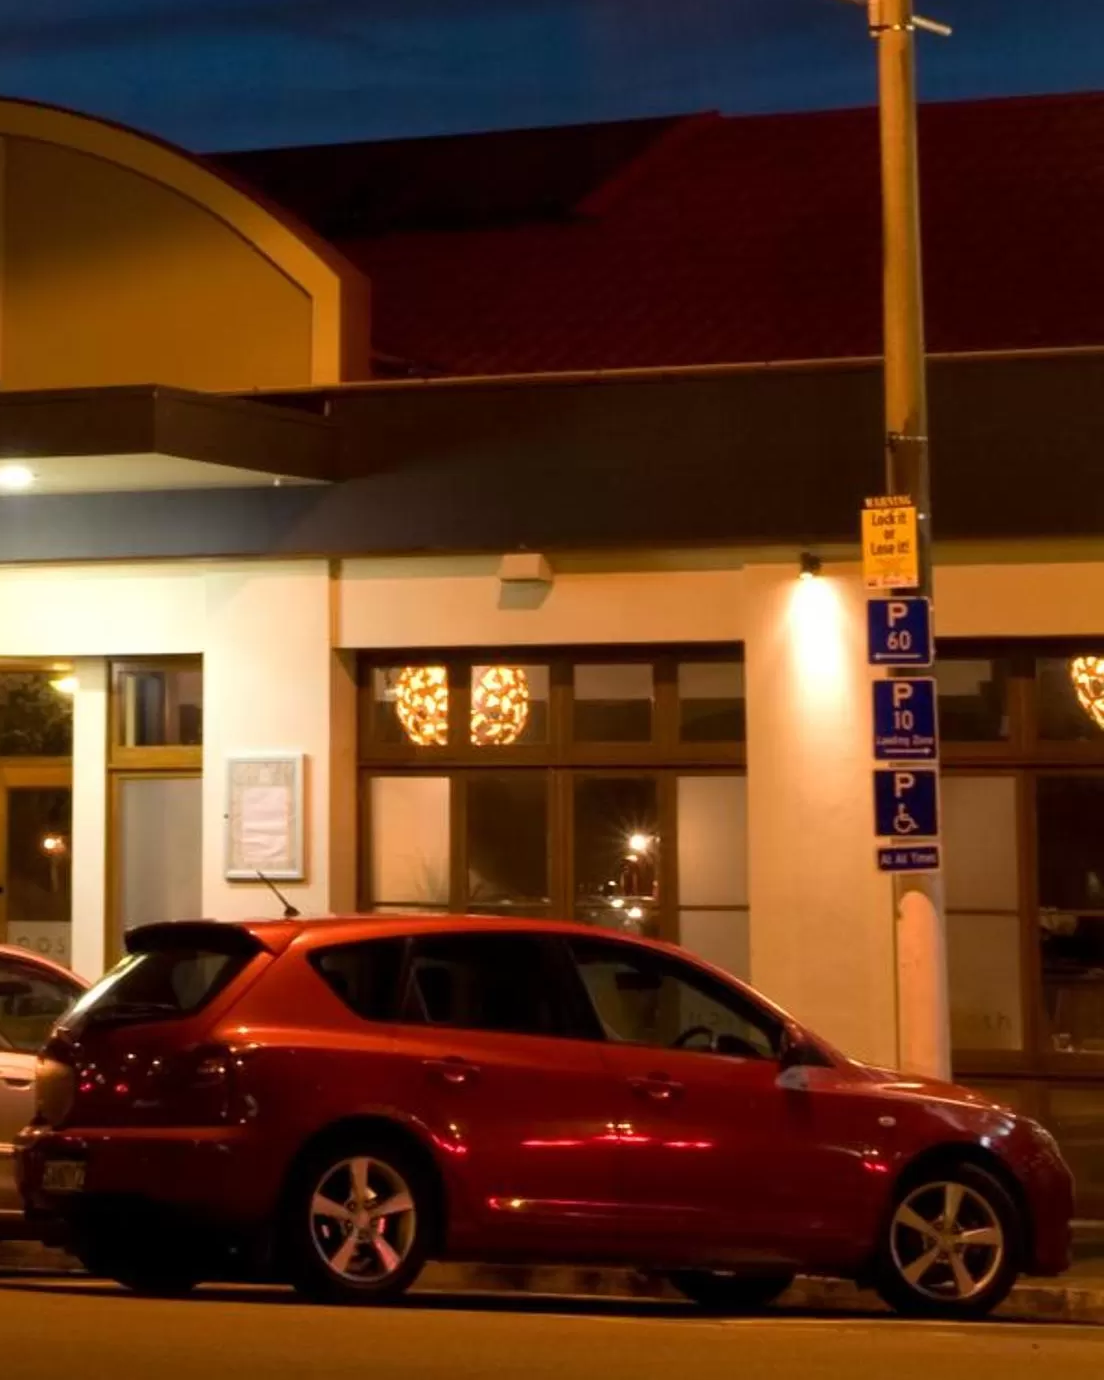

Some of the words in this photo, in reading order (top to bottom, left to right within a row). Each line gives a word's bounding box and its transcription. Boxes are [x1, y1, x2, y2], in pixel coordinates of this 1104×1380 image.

[871, 512, 895, 526] Lock
[887, 603, 908, 627] P
[887, 629, 911, 650] 60
[893, 683, 913, 708] P
[894, 711, 913, 730] 10
[895, 772, 915, 797] P
